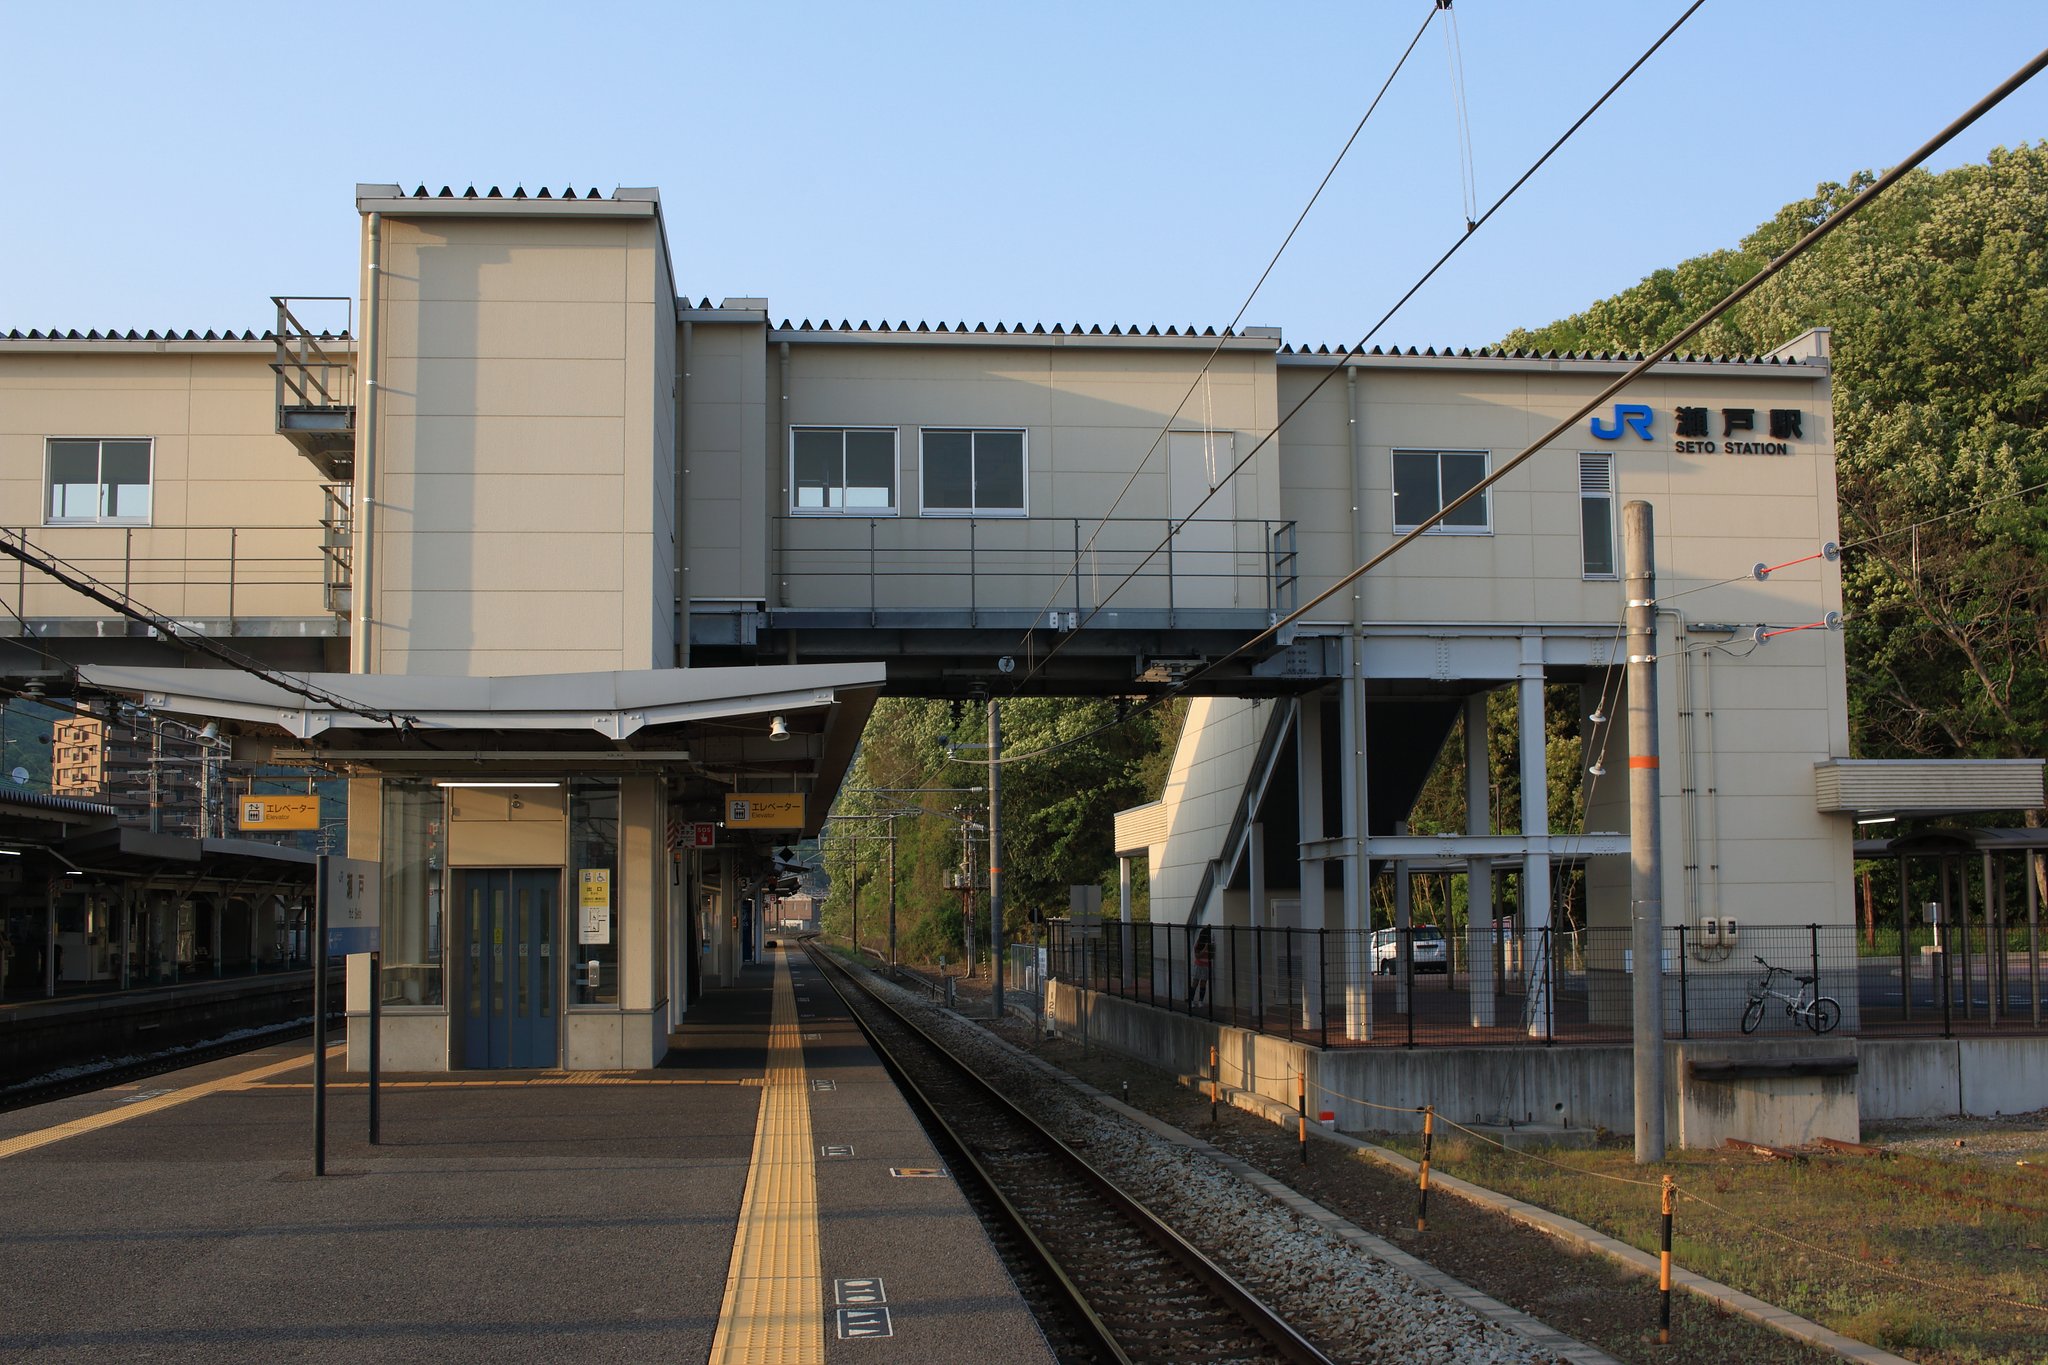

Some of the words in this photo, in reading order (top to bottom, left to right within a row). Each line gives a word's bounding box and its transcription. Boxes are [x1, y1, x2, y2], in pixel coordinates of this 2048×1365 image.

[1591, 404, 1654, 441] JR
[1674, 406, 1802, 439] 瀬戸駅
[1675, 441, 1716, 454] SETO
[1724, 441, 1787, 456] STATION
[266, 804, 316, 813] エレベーター
[751, 802, 801, 812] エレベーター
